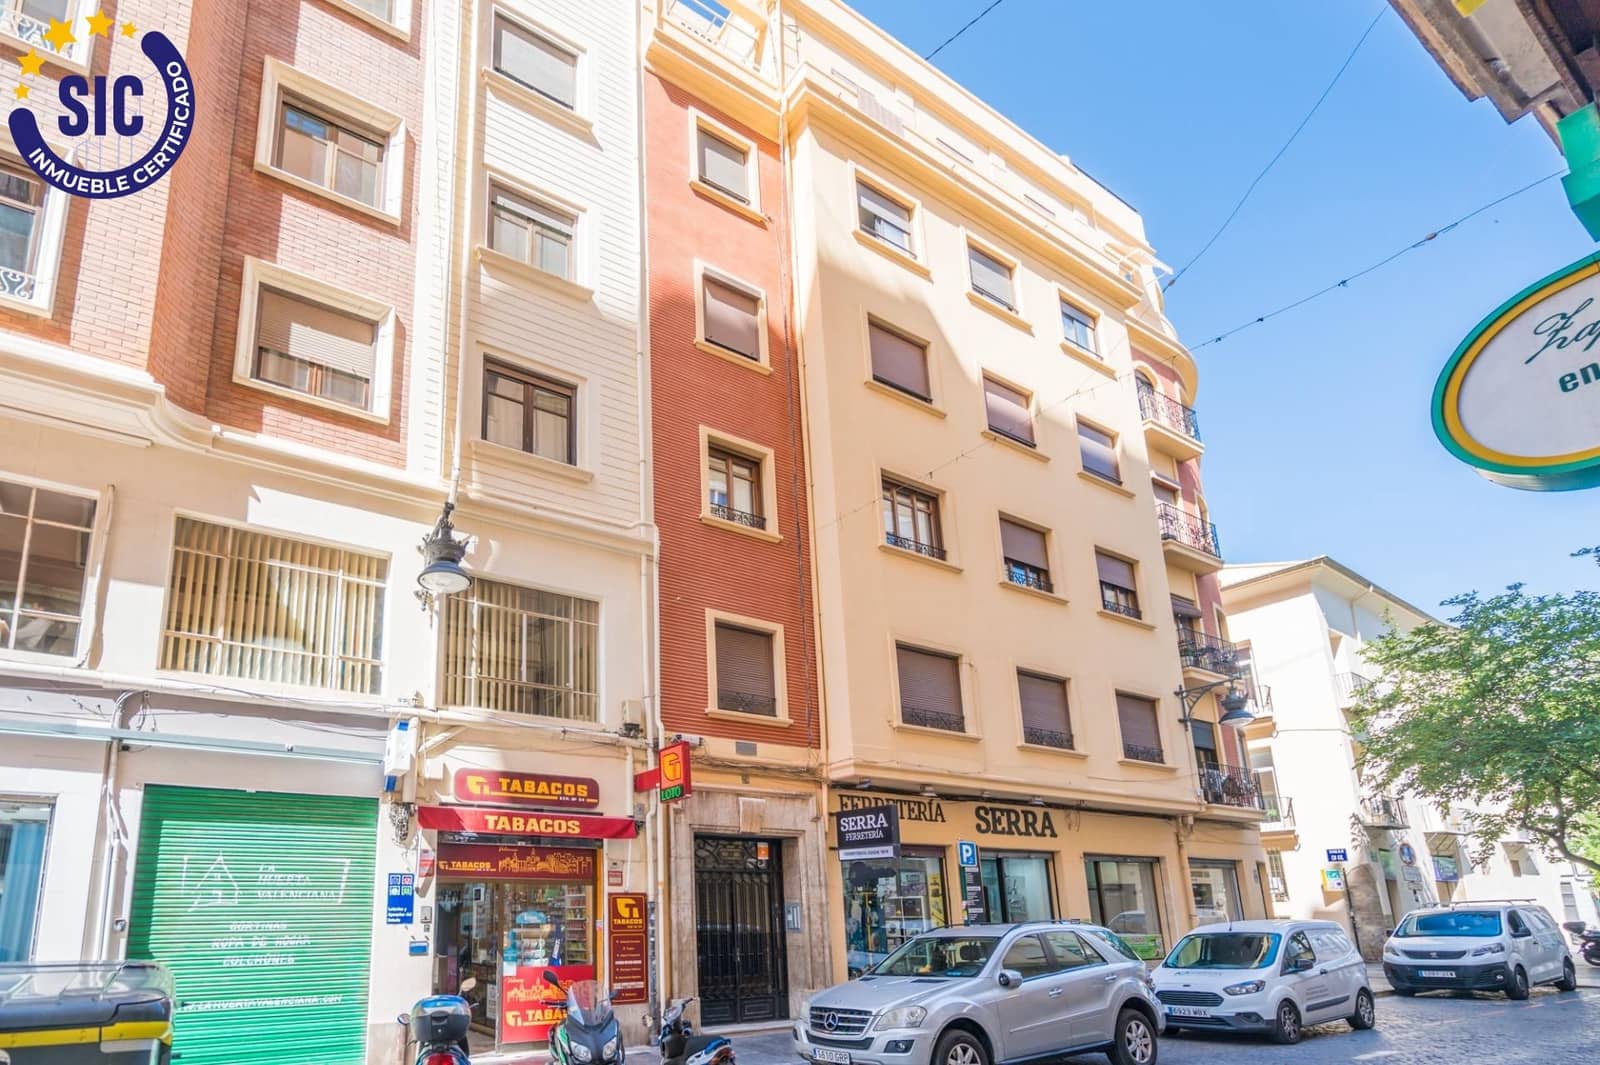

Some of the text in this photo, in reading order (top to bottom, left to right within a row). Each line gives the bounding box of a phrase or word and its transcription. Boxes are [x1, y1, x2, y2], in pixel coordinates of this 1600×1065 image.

[498, 777, 589, 797] TABACOS
[661, 785, 682, 801] LOTO
[485, 814, 581, 834] TABACOS
[840, 813, 888, 832] SERRA
[975, 805, 1059, 838] SERRA
[845, 829, 884, 841] FERRETERÍA
[961, 844, 973, 863] P
[451, 860, 491, 869] TABACOS
[526, 1009, 568, 1022] TABA
